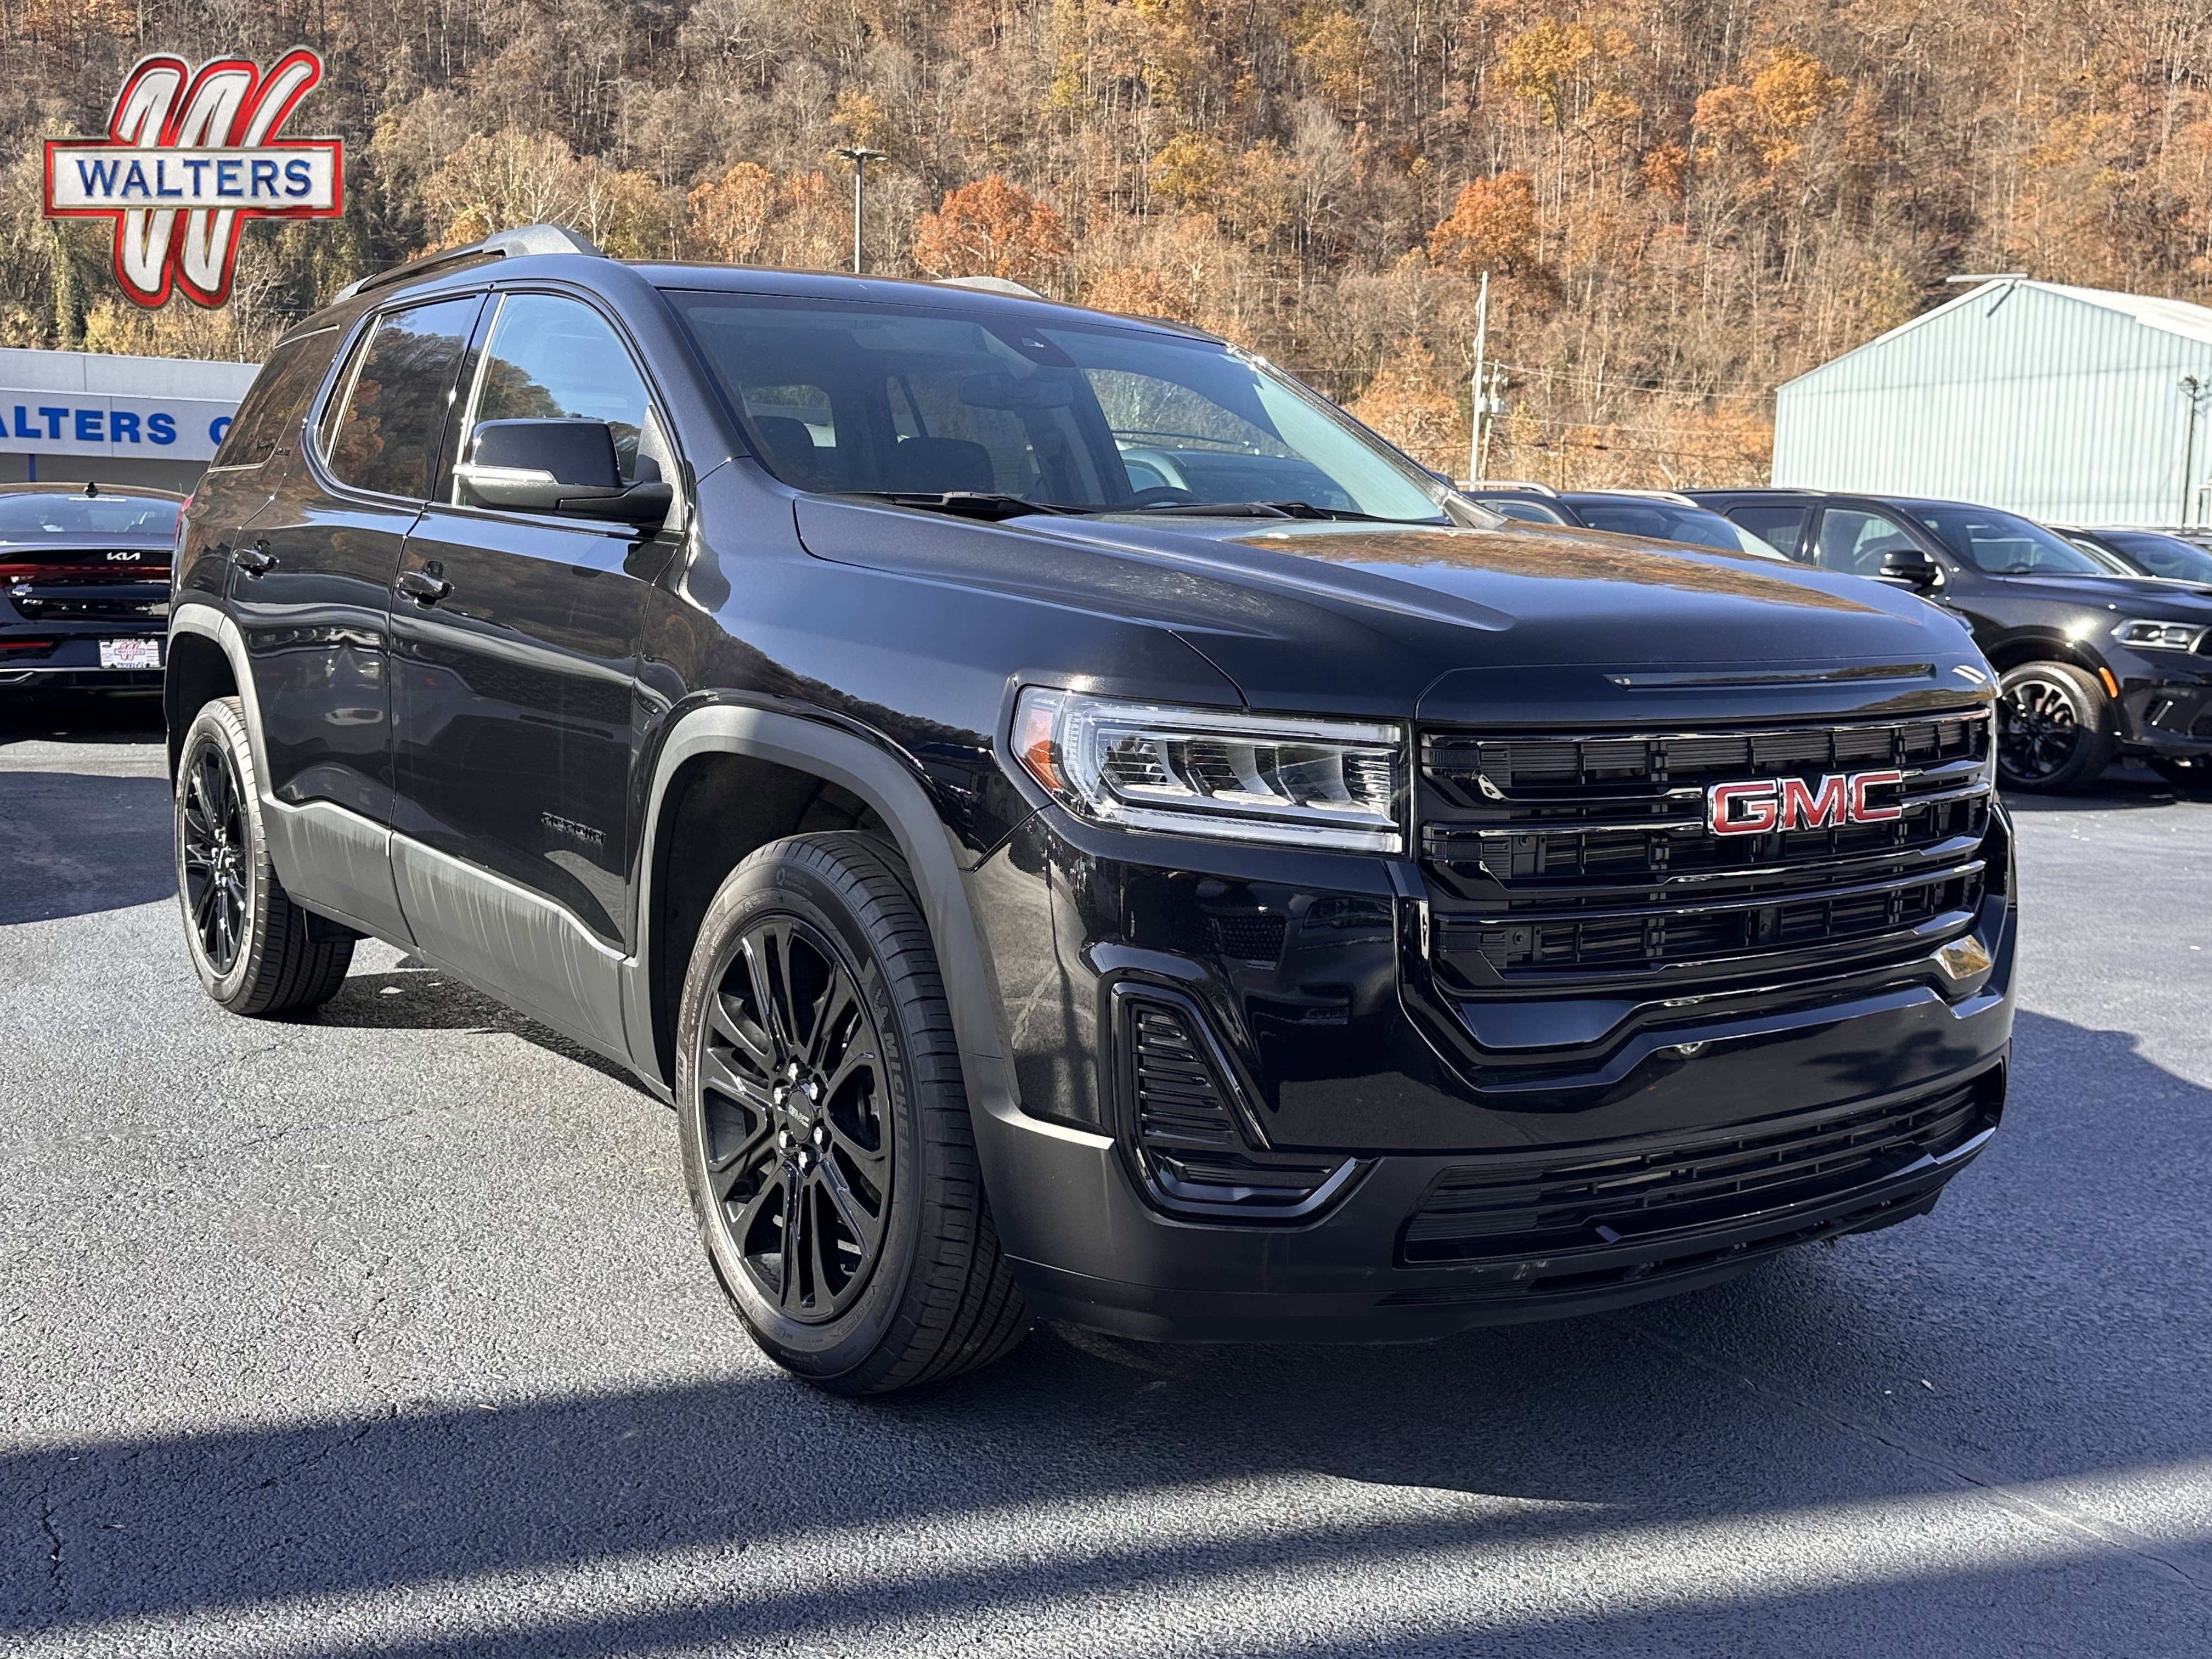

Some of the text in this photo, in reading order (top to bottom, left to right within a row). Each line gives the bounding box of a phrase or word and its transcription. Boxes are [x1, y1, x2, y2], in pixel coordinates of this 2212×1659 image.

[0, 405, 177, 445] LTERS
[106, 552, 140, 561] KIA
[1707, 769, 1903, 837] GMC
[788, 1104, 809, 1128] GMC
[883, 1031, 911, 1195] MICHELIN
